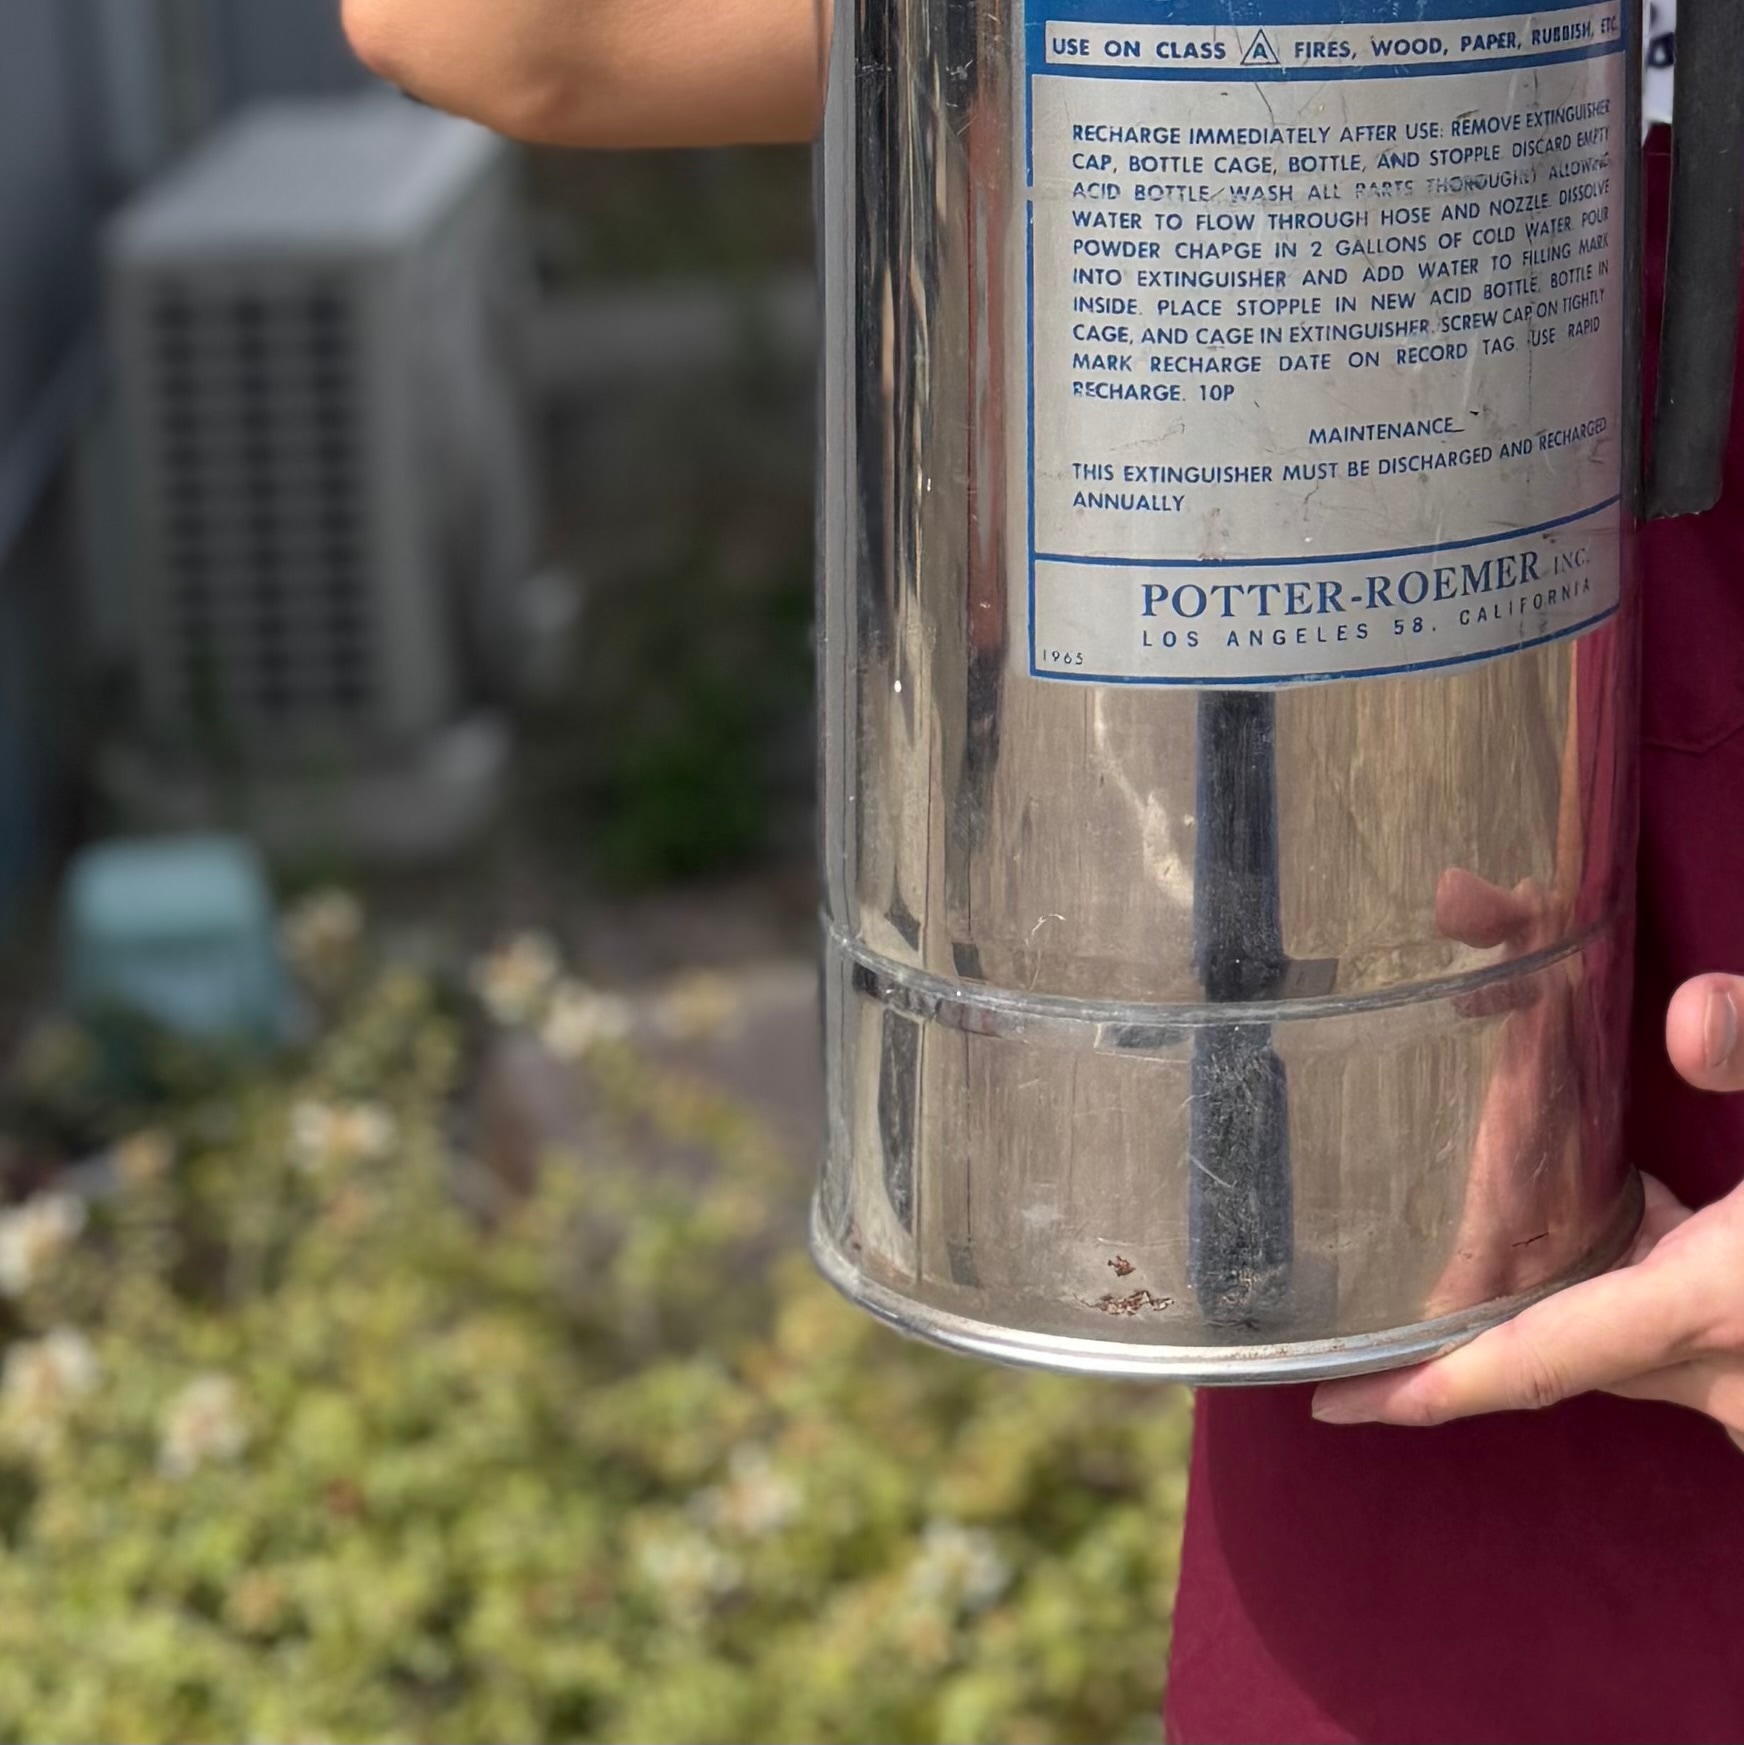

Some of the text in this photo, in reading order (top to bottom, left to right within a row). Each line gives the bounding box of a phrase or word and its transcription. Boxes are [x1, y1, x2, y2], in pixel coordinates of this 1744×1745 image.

[1053, 37, 1090, 56] USE
[1104, 41, 1141, 57] ON
[1156, 42, 1226, 59] CLASS
[1295, 41, 1357, 60] FIRES,
[1371, 38, 1448, 56] WOOD,
[1460, 32, 1522, 52] PAPER,
[1073, 125, 1181, 144] RECHARGE
[1189, 126, 1331, 144] IMMEDIATELY
[1340, 125, 1396, 142] AFTER
[1451, 114, 1520, 137] REMOVE
[1526, 99, 1611, 128] EXTINGUISHER
[1073, 154, 1117, 174] CAP,
[1130, 156, 1203, 173] BOTTLE
[1214, 156, 1277, 175] CAGE,
[1289, 154, 1366, 173] BOTTLE,
[1378, 152, 1420, 169] AND
[1513, 136, 1571, 157] DISCARD
[1577, 127, 1609, 149] EMPTY
[1073, 182, 1121, 200] ACID
[1230, 184, 1293, 203] WASH
[1308, 185, 1341, 200] ALL
[1356, 180, 1413, 198] PARTS
[1073, 210, 1142, 229] WATER
[1155, 213, 1183, 230] TO
[1196, 213, 1255, 230] FLOW
[1268, 210, 1368, 230] THROUGH
[1381, 207, 1431, 226] HOSE
[1441, 202, 1480, 221] AND
[1559, 179, 1610, 205] DISSOLVE
[1073, 239, 1160, 259] POWDER
[1275, 242, 1297, 259] IN
[1311, 241, 1322, 257] 2
[1336, 235, 1427, 255] GALLONS
[1438, 232, 1462, 249] OF
[1473, 226, 1515, 246] COLD
[1582, 206, 1609, 228] POUR
[1073, 232, 1608, 288] INTO EXTINGUISHER AND ADD WATER TO FILLING MARK
[1073, 296, 1142, 315] INSIDE.
[1158, 299, 1222, 316] PLACE
[1237, 297, 1321, 316] STOPPLE
[1336, 296, 1356, 311] IN
[1371, 292, 1416, 311] NEW
[1430, 287, 1472, 305] ACID
[1551, 264, 1592, 289] BOTTLE
[1599, 259, 1609, 276] IN
[1073, 324, 1134, 345] CAGE,
[1141, 328, 1188, 345] AND
[1196, 327, 1253, 345] CAGE
[1260, 327, 1282, 344] IN
[1442, 311, 1498, 333] SCREW
[1503, 305, 1533, 324] CAP
[1536, 301, 1558, 318] ON
[1563, 288, 1605, 313] TIGHTLY
[1073, 353, 1132, 371] MARK
[1150, 355, 1261, 373] RECHARGE
[1279, 354, 1331, 372] DATE
[1348, 352, 1380, 368] ON
[1397, 343, 1468, 365] RECORD
[1531, 328, 1556, 348] USE
[1568, 316, 1600, 338] RAPID
[1200, 384, 1235, 401] 10P
[1072, 417, 1607, 484] THIS EXTINGUISHER MUST BE DISCHARGED AND RECHARGED
[1309, 417, 1453, 444] MAINTENANCE
[1072, 491, 1185, 512] ANNUALLY
[1141, 550, 1541, 618] POTTER-ROEMER
[1143, 630, 1199, 648] LOS
[1227, 623, 1368, 647] ANGELES
[1459, 577, 1590, 625] CALIFORNIA
[1042, 650, 1084, 666] 1965
